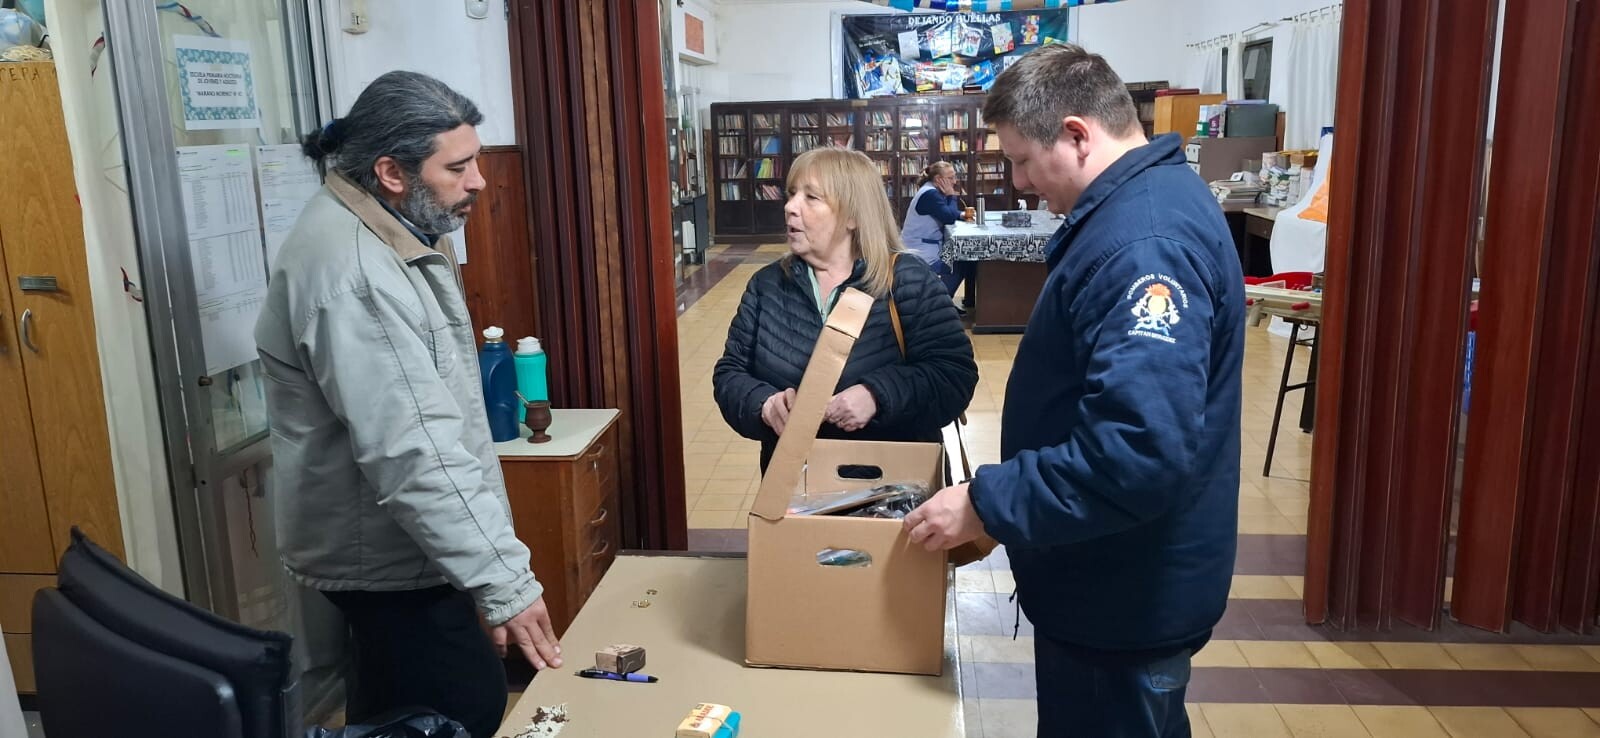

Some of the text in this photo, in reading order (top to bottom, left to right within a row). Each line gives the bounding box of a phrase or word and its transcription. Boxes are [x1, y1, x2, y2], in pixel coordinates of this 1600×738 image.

[908, 12, 1001, 25] DEJANDO HUELLAS
[1126, 272, 1189, 309] BOMBEROS VOLUNTARIOS
